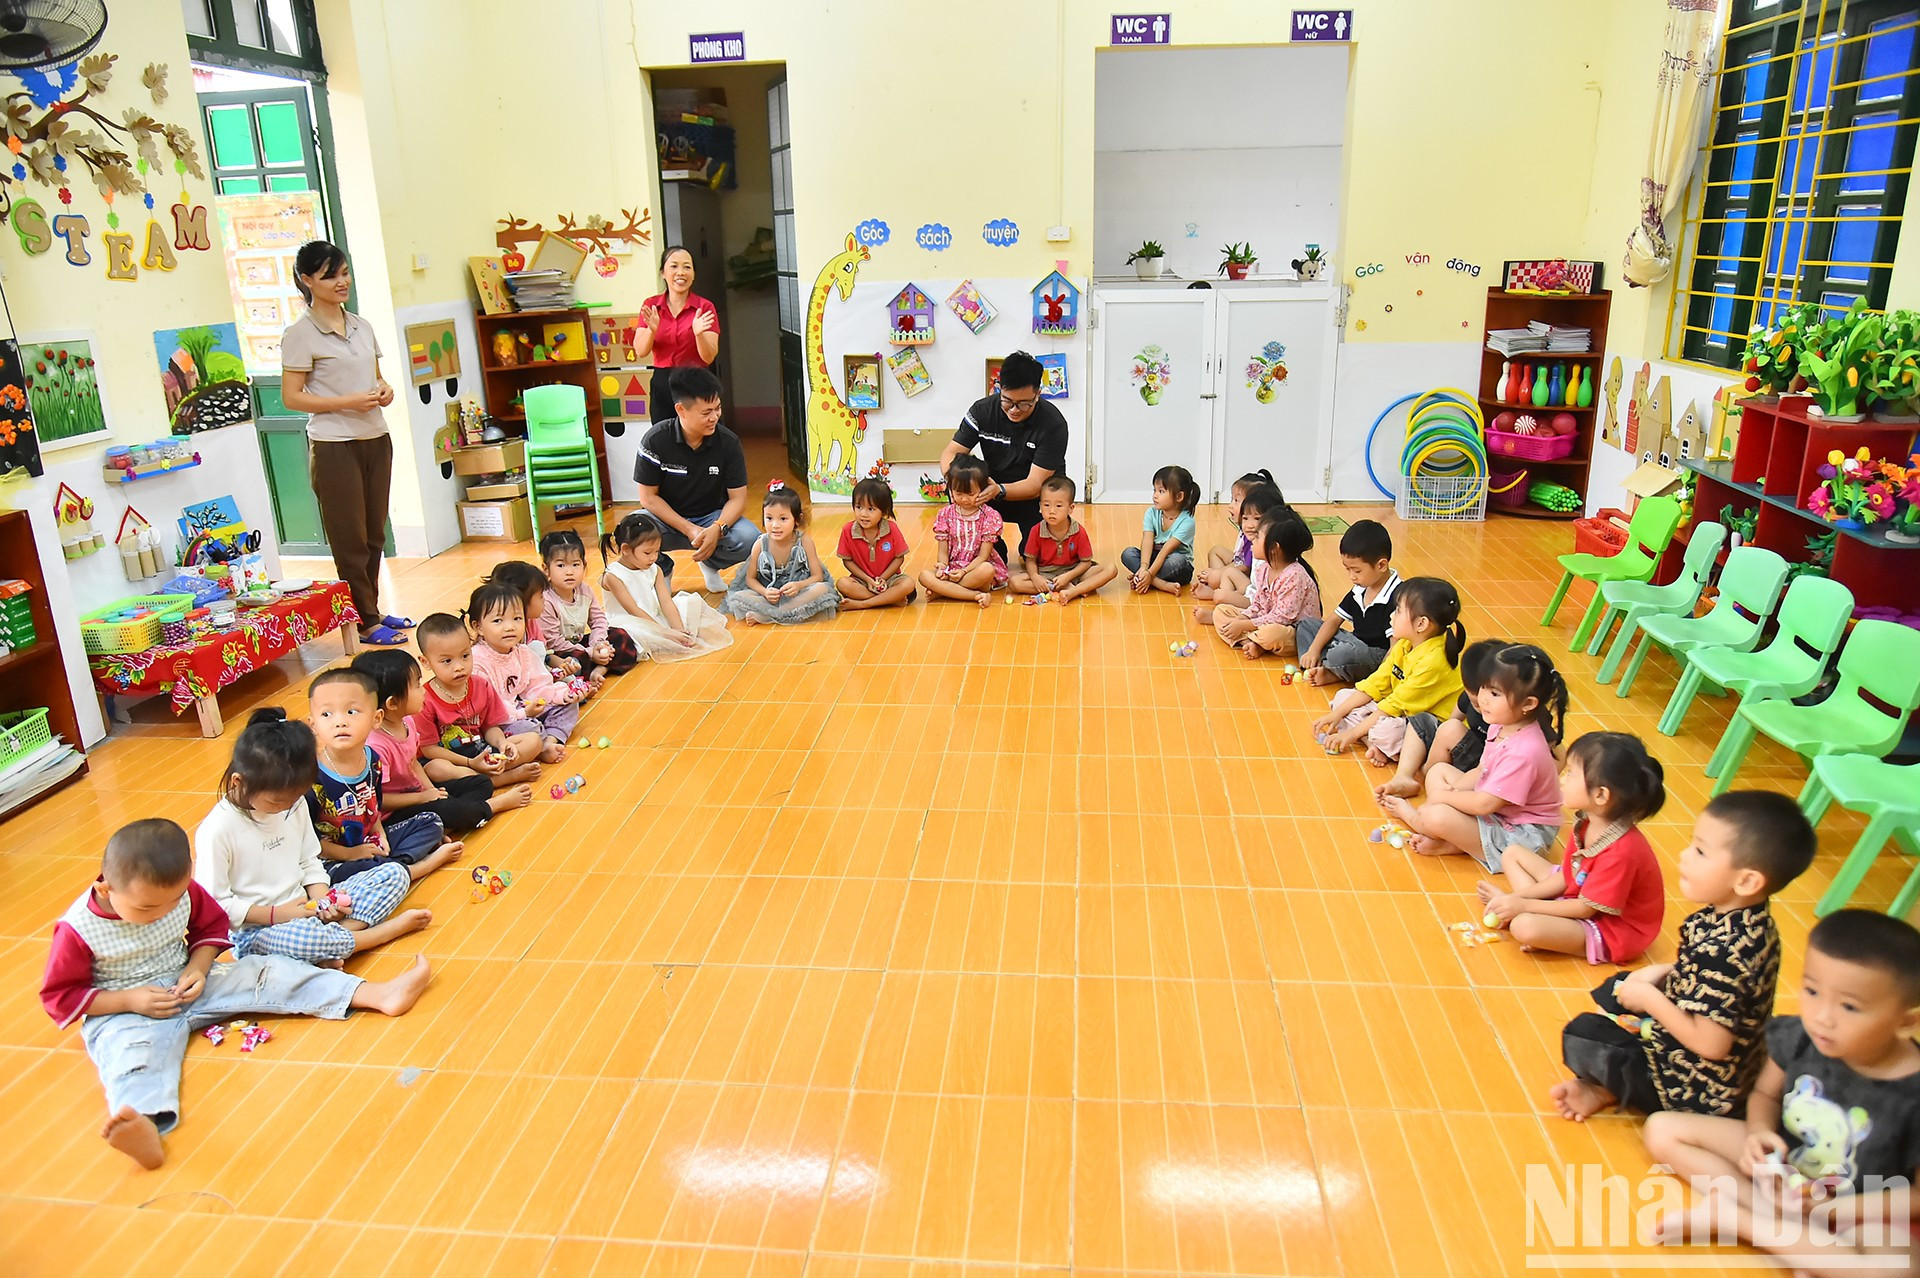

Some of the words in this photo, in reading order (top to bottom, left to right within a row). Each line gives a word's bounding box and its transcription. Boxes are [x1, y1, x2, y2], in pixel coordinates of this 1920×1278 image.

[1116, 18, 1148, 34] WC
[1296, 14, 1329, 30] WC
[1304, 31, 1318, 39] NỮ
[692, 37, 723, 59] PHÒNG
[723, 39, 742, 57] KHO
[10, 197, 211, 282] STEAM
[860, 224, 884, 242] Góc
[919, 228, 950, 246] sách
[983, 225, 1018, 243] truyện
[1355, 262, 1385, 278] Góc
[1405, 251, 1430, 267] vận
[1446, 257, 1481, 278] động
[610, 331, 617, 344] 1
[600, 351, 608, 363] 3
[626, 349, 636, 362] 4
